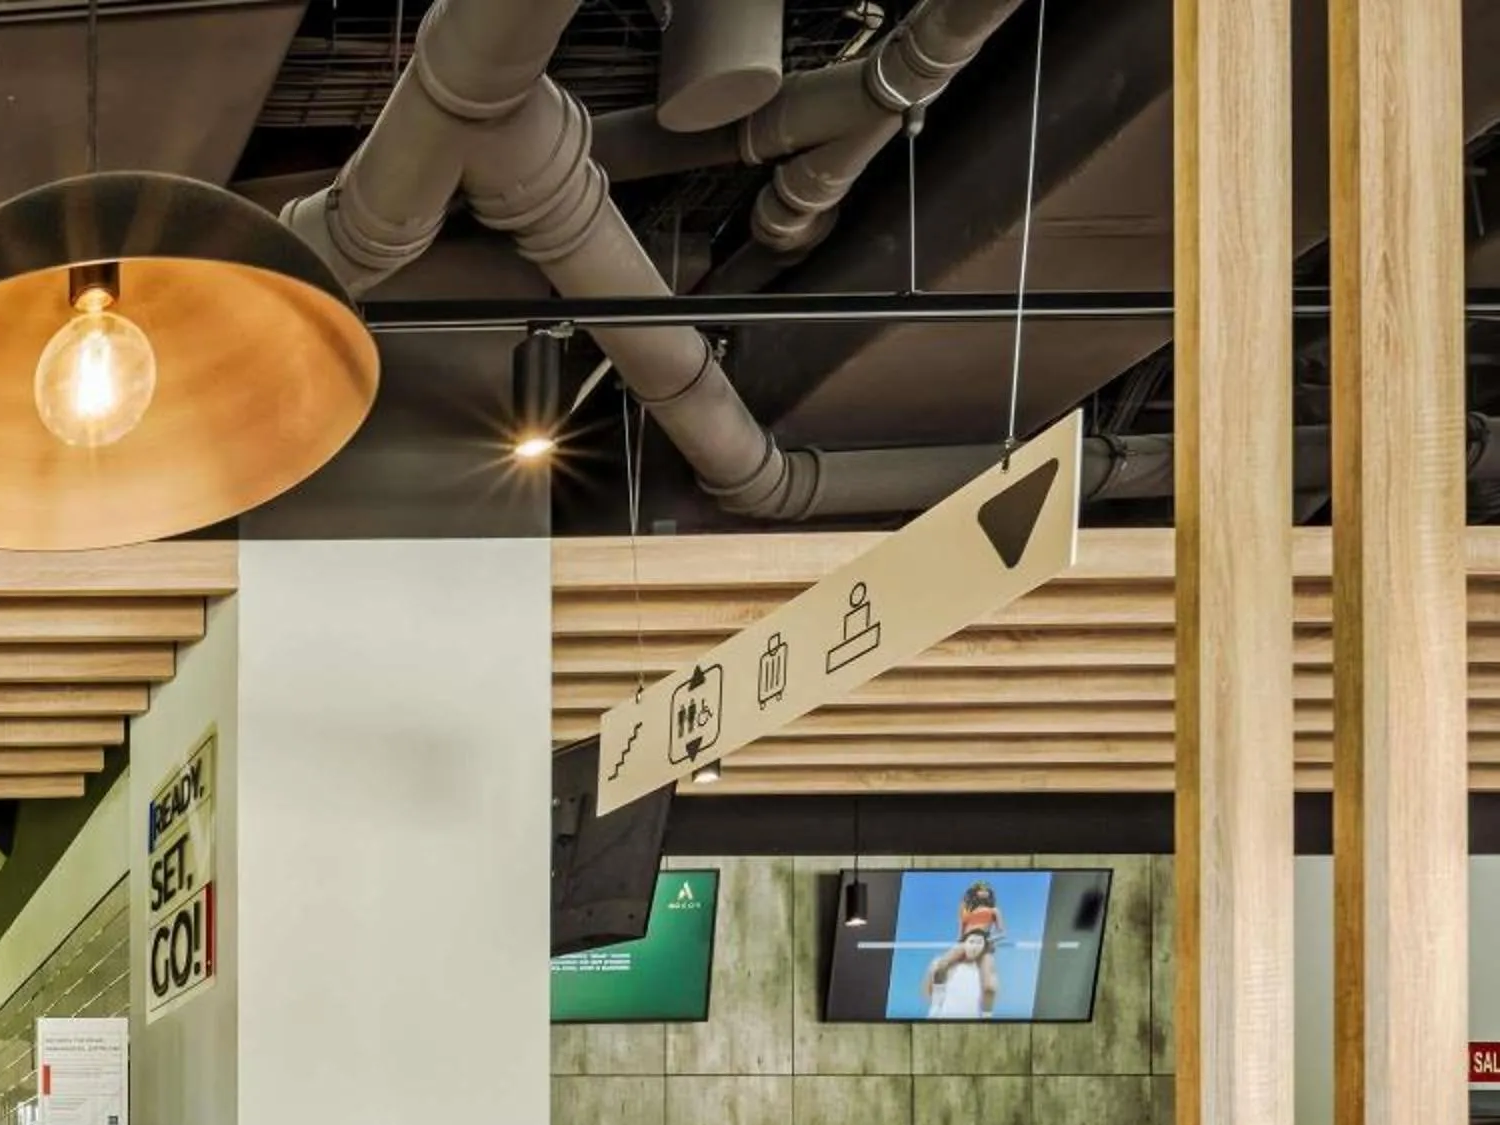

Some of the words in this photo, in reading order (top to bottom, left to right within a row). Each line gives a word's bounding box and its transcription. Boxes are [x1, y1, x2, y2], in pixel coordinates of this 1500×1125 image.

[151, 832, 192, 911] SET,
[151, 900, 201, 997] GO!
[1473, 1051, 1500, 1073] SAL
